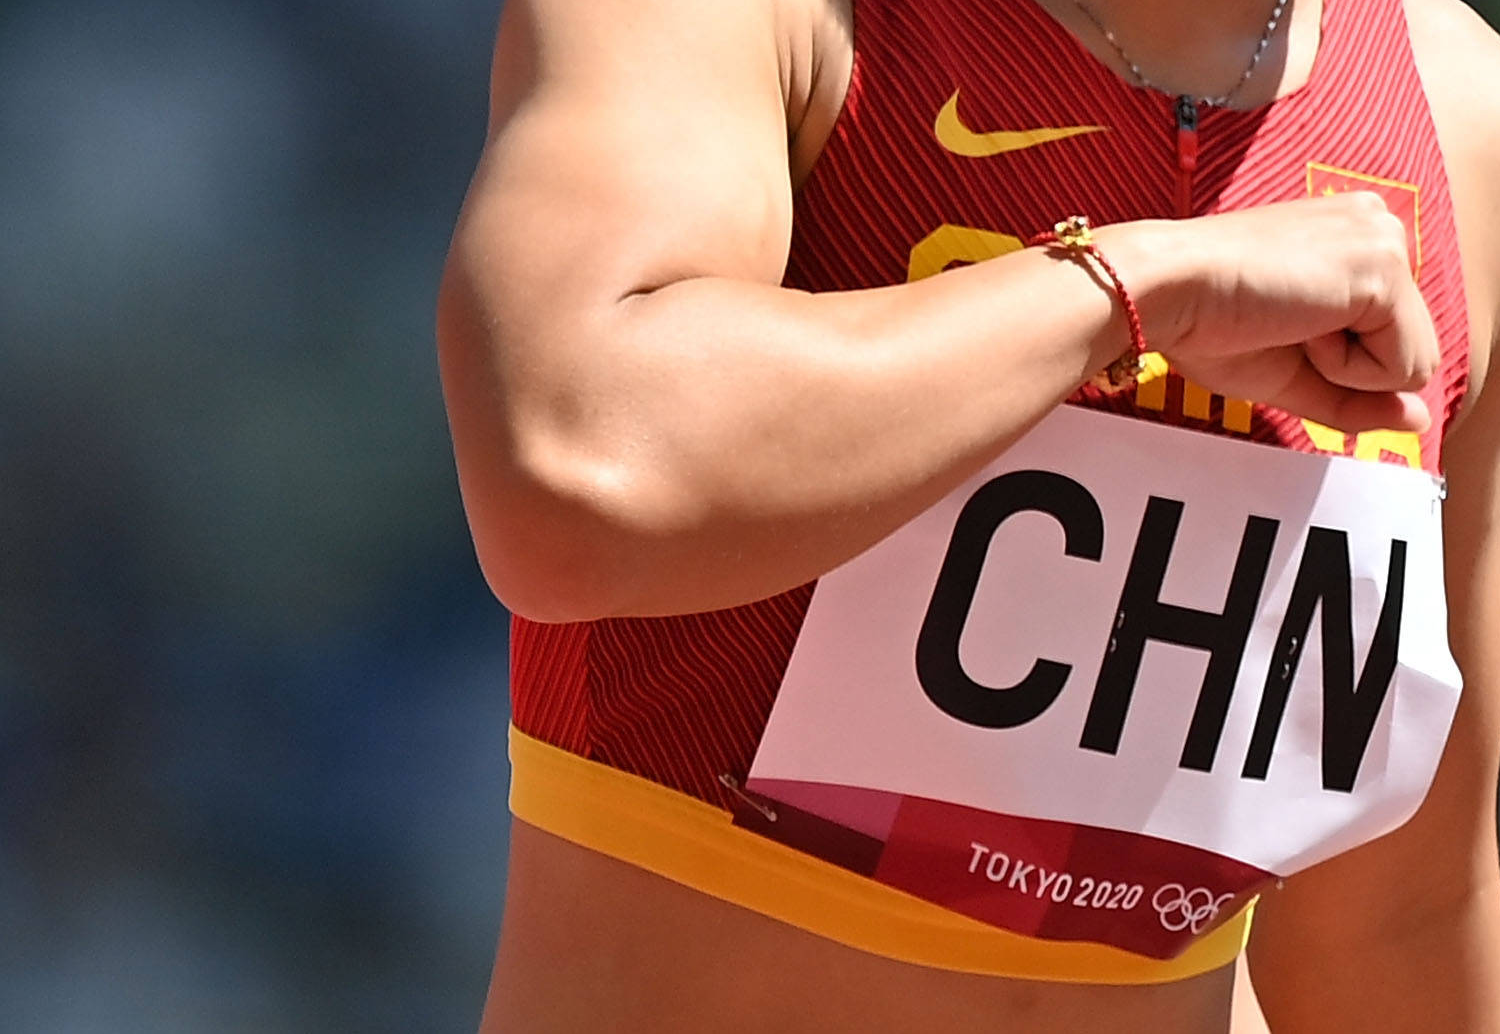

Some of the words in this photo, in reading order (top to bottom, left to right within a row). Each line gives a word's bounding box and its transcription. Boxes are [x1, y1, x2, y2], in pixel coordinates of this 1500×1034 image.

[915, 468, 1408, 794] CHN
[968, 841, 1073, 903] TOKYO
[1073, 877, 1144, 910] 2020
